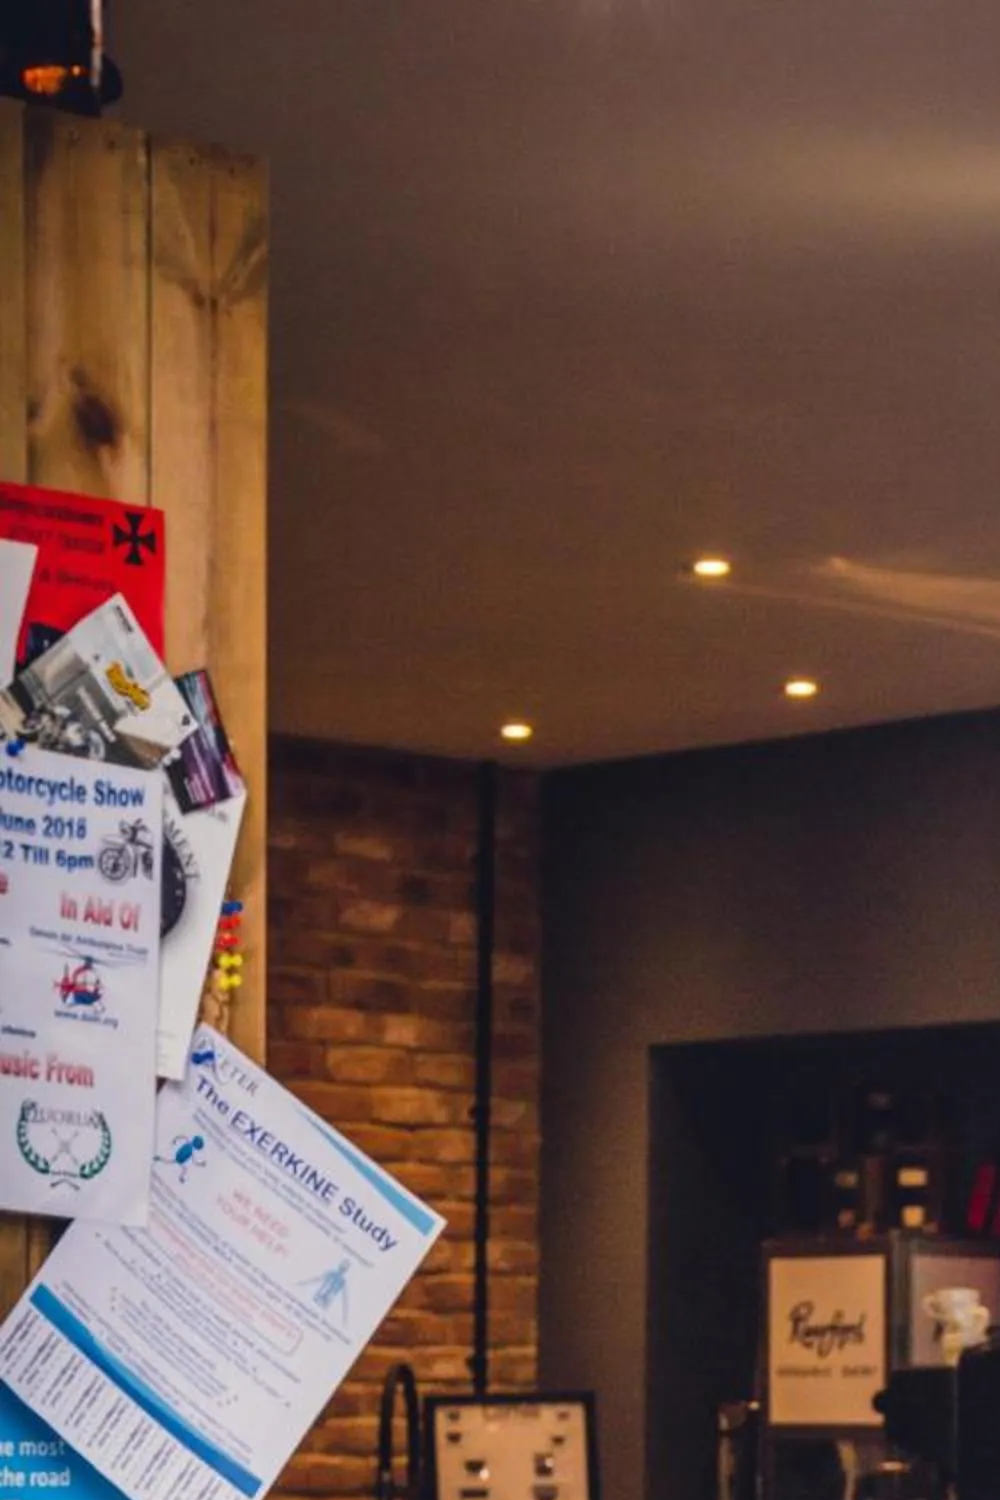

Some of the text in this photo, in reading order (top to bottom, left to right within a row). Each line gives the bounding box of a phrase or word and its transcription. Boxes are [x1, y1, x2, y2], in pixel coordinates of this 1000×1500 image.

[0, 767, 146, 807] torcycle Show
[20, 844, 49, 865] Till
[55, 850, 94, 872] 6pm
[60, 891, 78, 920] In
[46, 1054, 95, 1089] From
[196, 1077, 230, 1115] The
[231, 1109, 341, 1202] EXERKINE
[338, 1197, 399, 1253] Study
[30, 1466, 72, 1488] road
